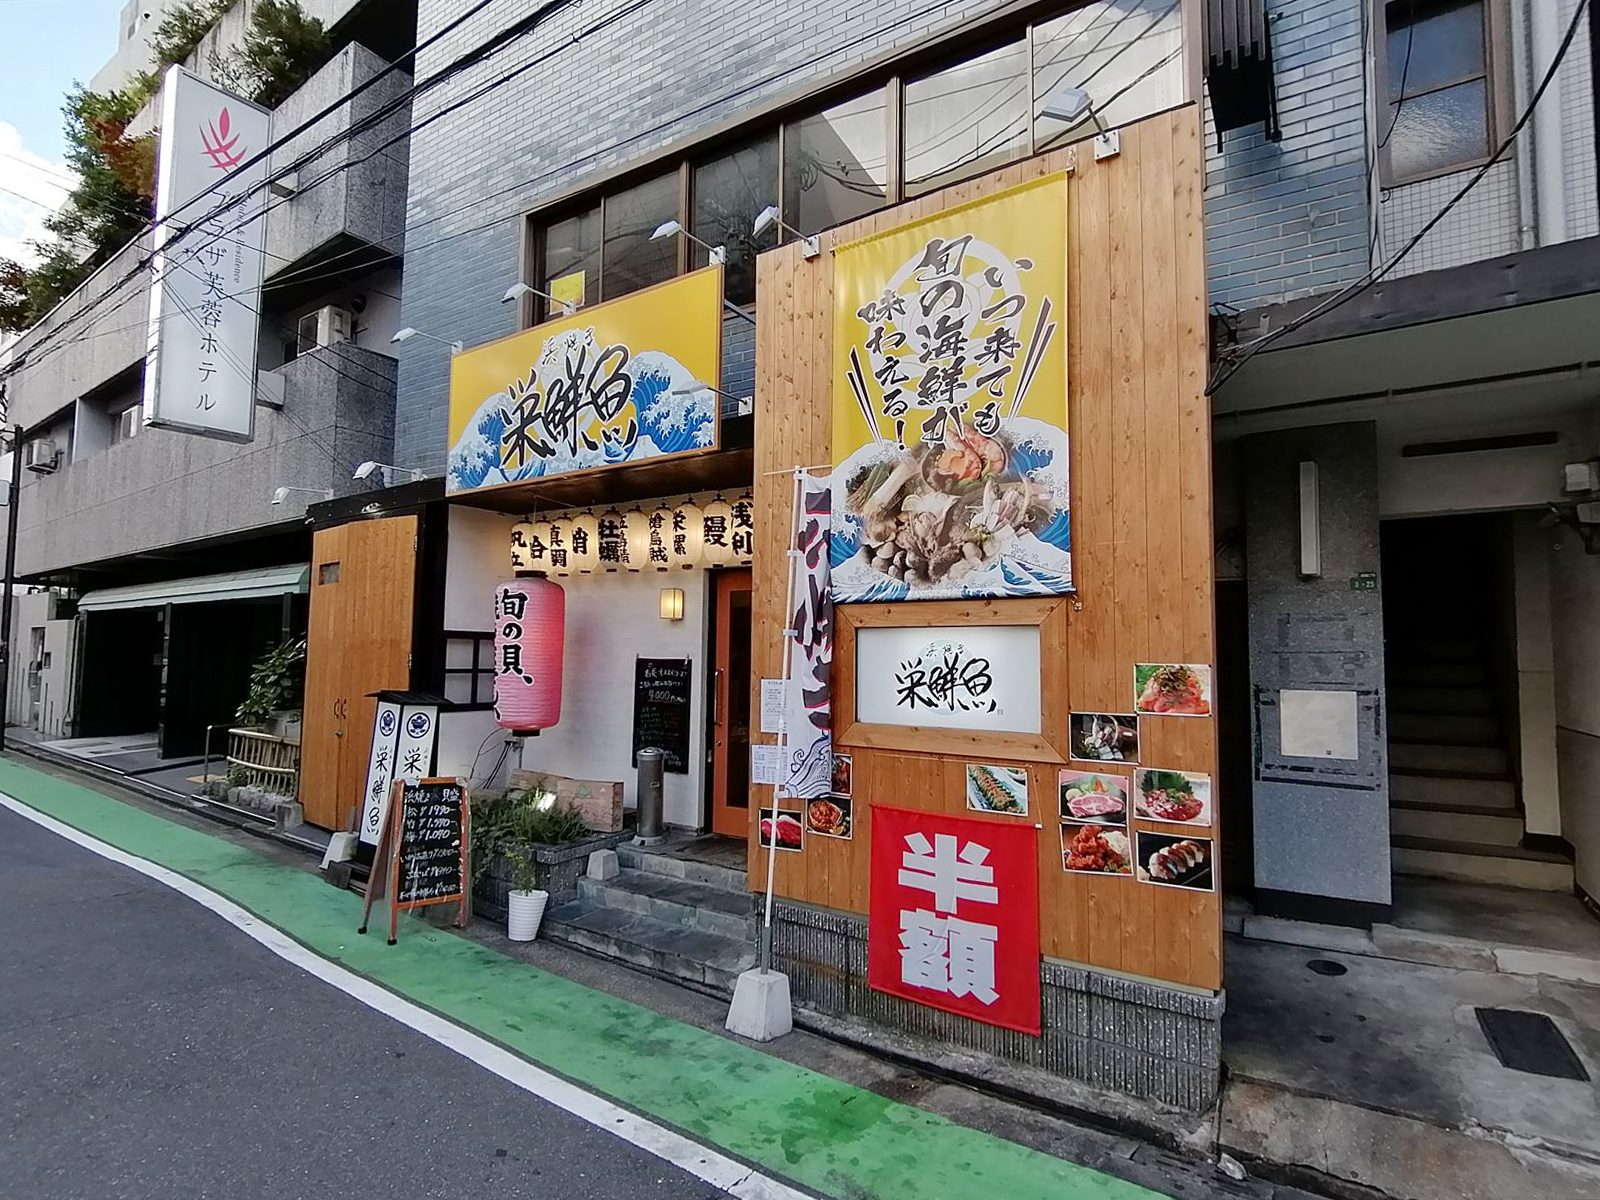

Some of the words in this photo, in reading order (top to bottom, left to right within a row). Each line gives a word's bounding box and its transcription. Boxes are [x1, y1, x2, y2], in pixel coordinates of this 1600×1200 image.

[912, 235, 973, 442] 旬の海鮮が
[973, 258, 1033, 435] いつ来ても
[897, 831, 1001, 1006] 半額
